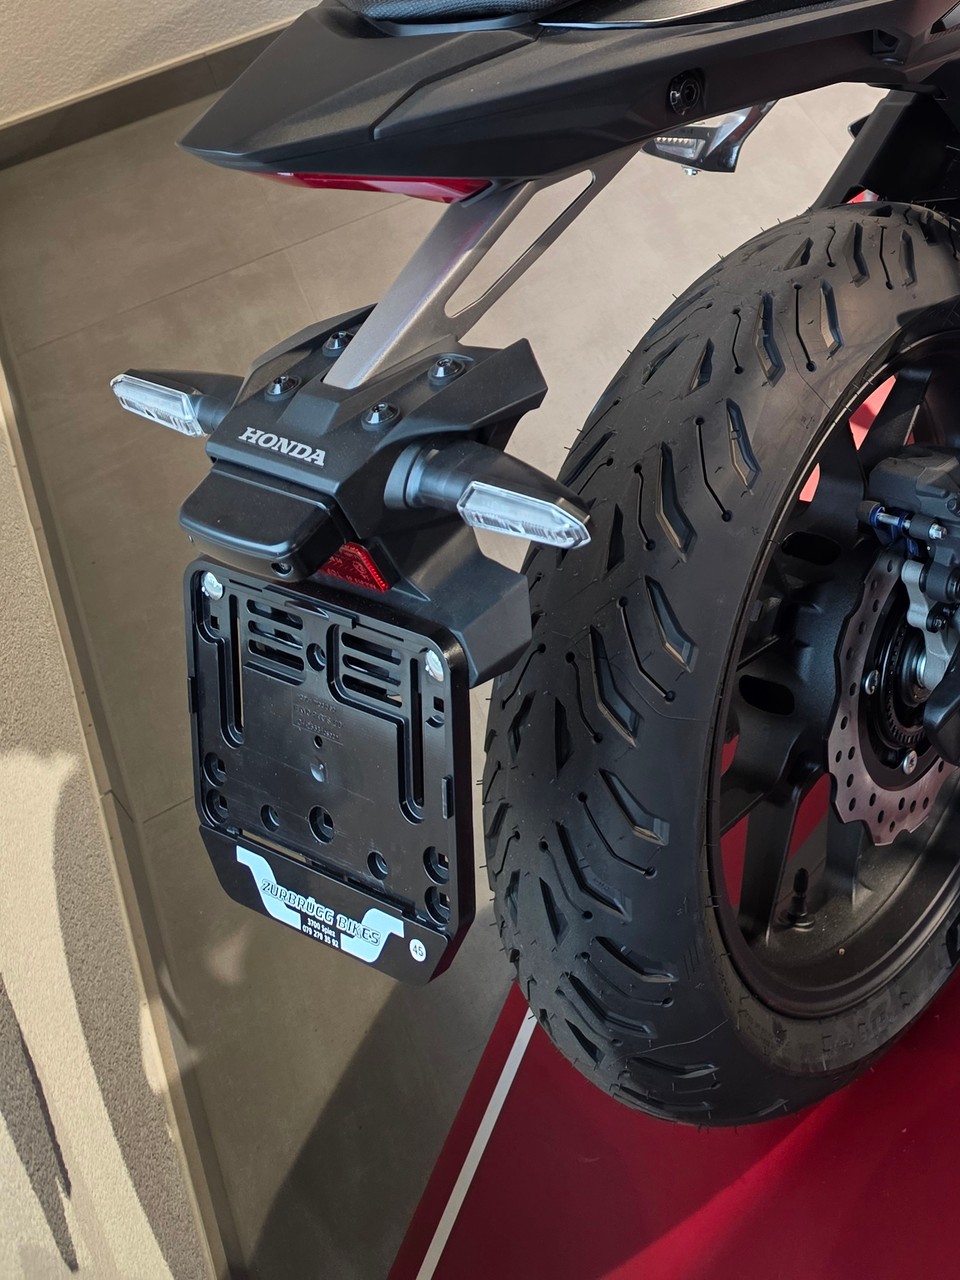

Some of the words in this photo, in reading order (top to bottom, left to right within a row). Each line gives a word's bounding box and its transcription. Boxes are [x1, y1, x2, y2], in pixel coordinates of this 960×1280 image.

[238, 426, 326, 467] HONDA
[261, 878, 335, 926] ZURBRÜGG
[336, 914, 382, 947] BIKES
[412, 943, 424, 957] 45
